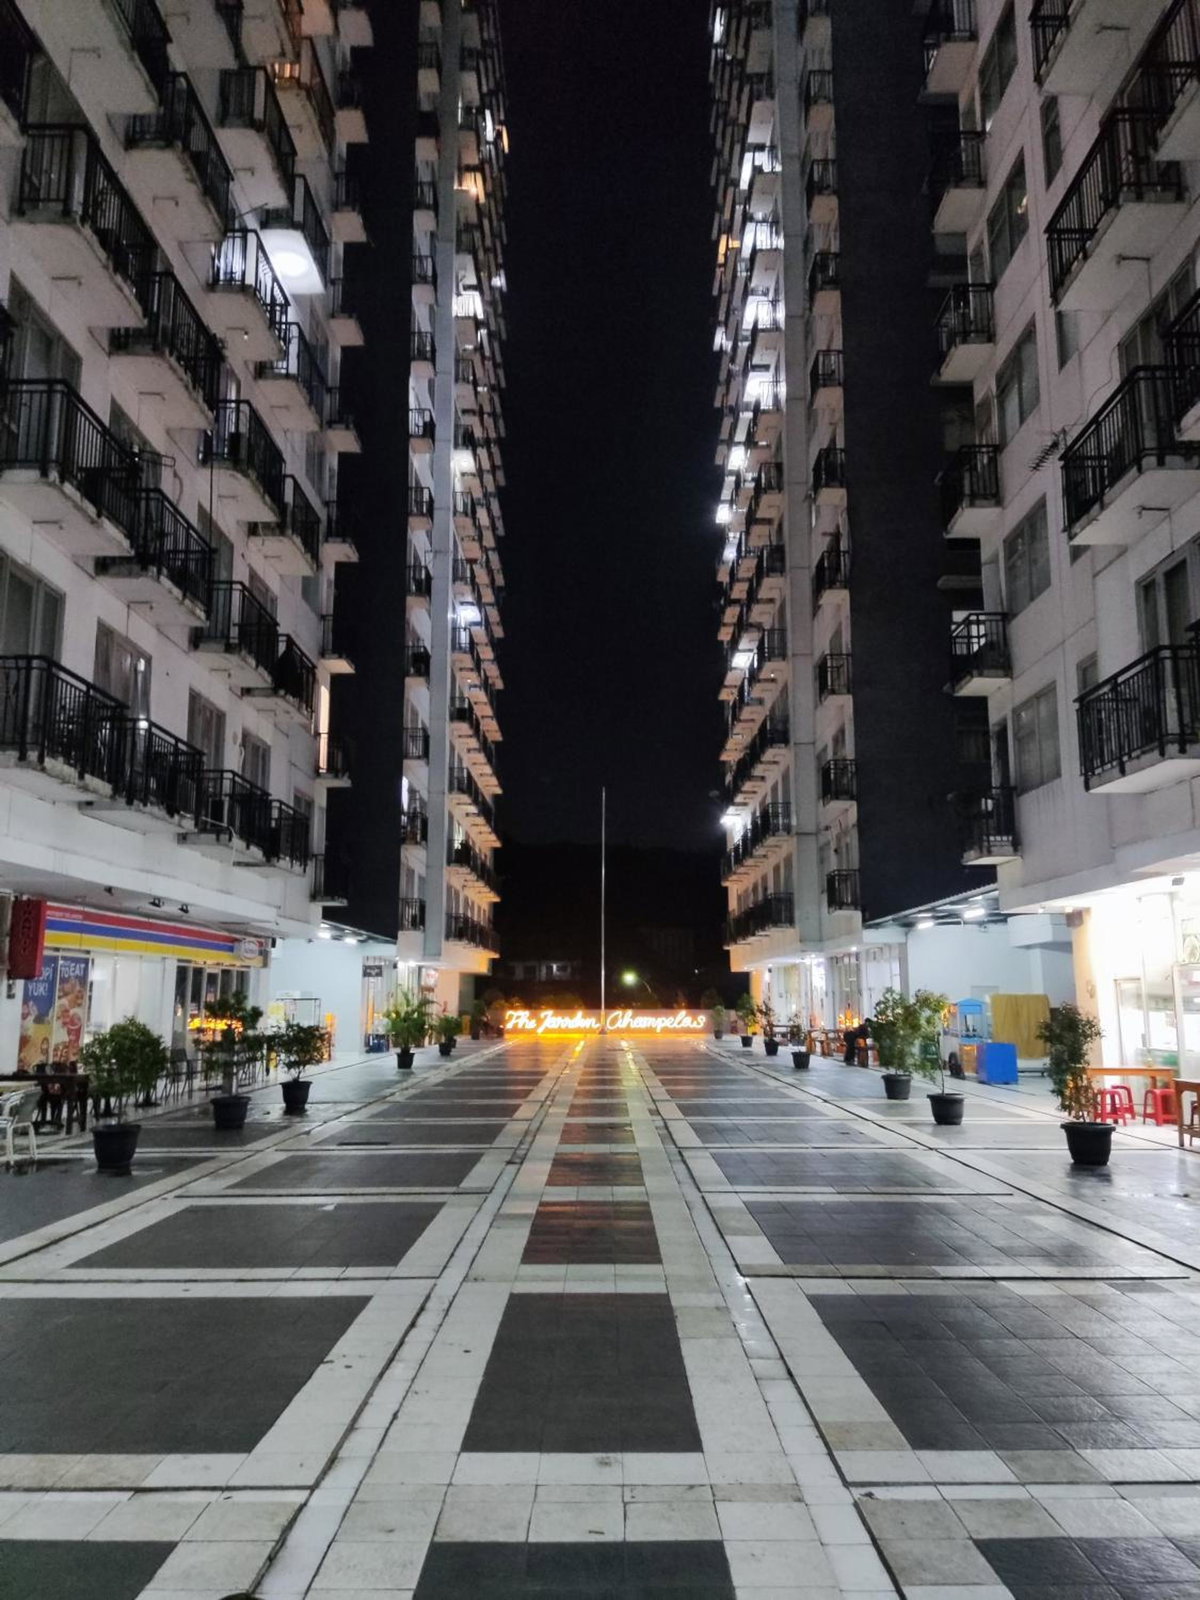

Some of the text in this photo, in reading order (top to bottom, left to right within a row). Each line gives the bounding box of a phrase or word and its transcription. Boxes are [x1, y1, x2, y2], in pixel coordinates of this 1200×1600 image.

[69, 963, 85, 977] EAT
[28, 982, 48, 997] YUK!
[505, 1010, 537, 1029] The
